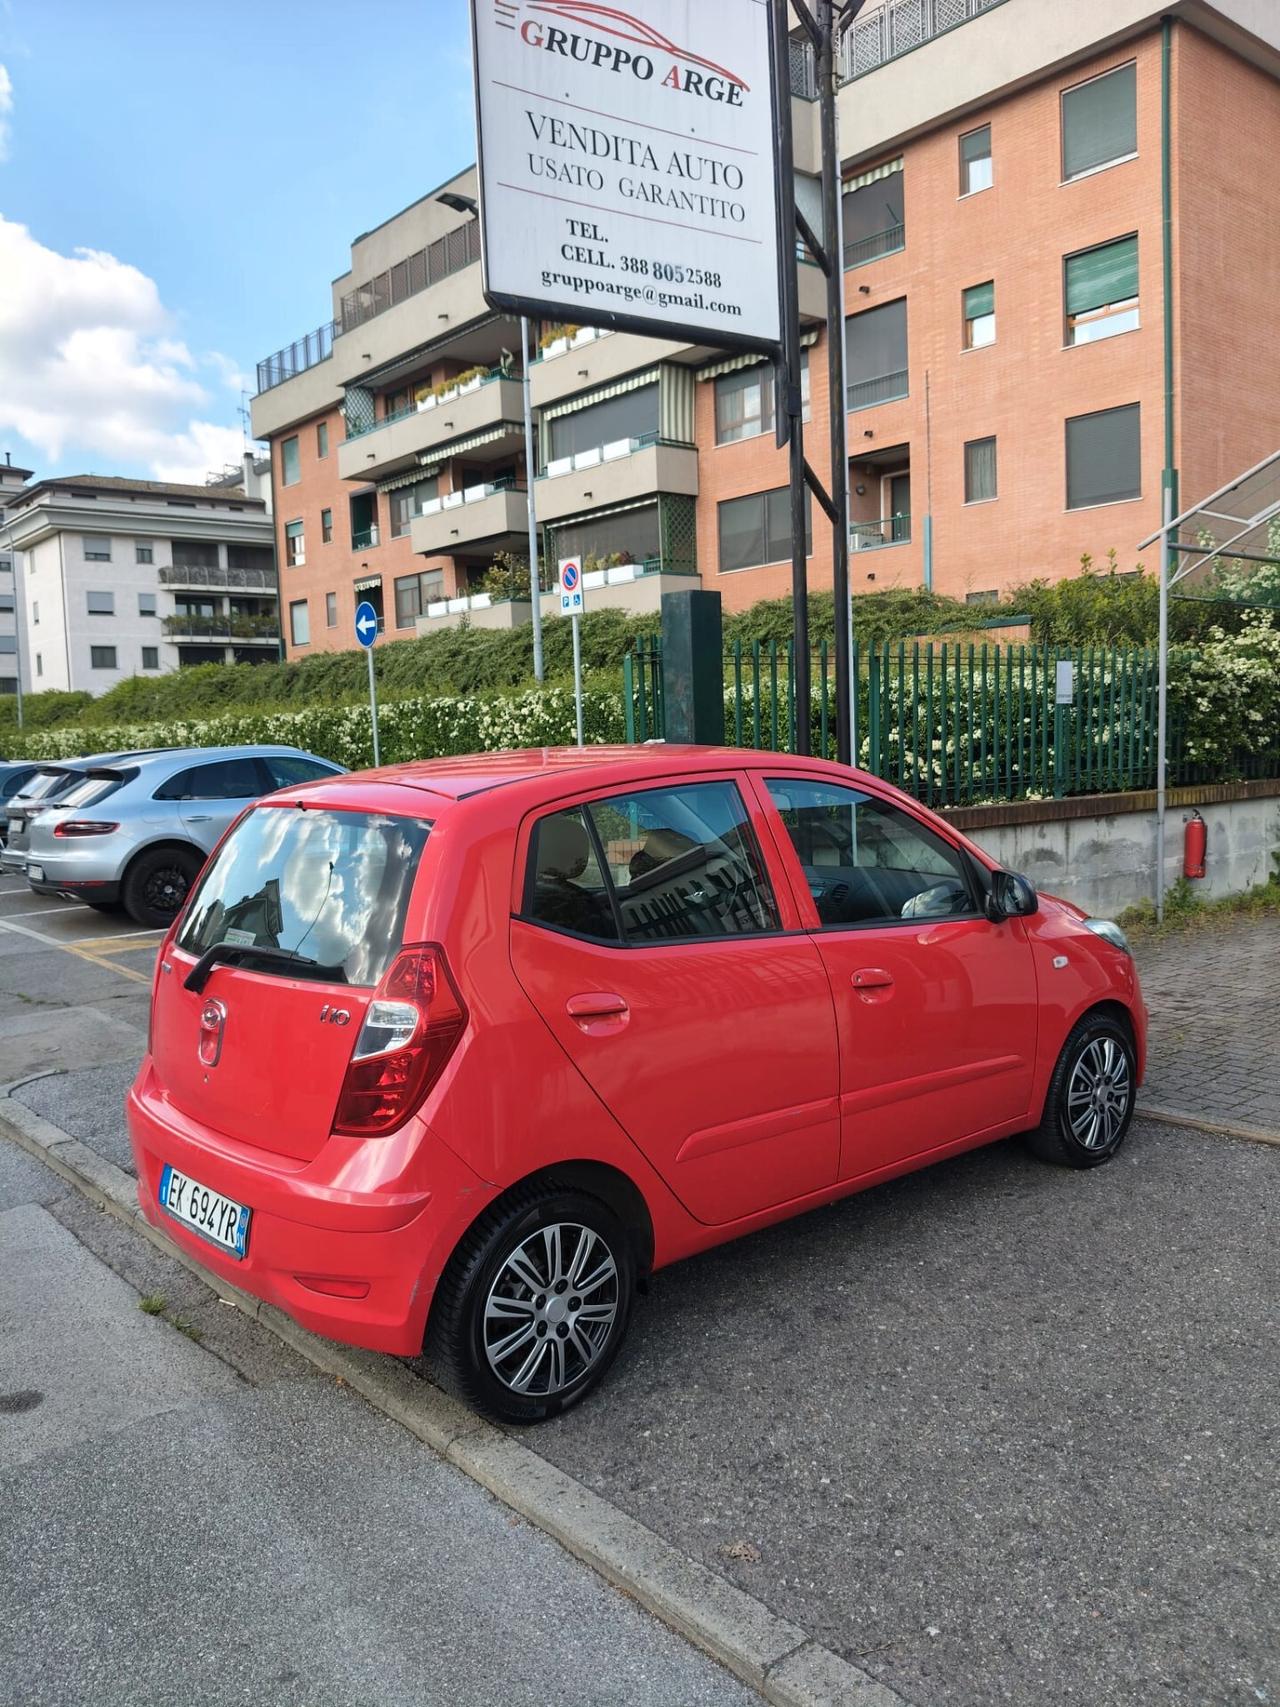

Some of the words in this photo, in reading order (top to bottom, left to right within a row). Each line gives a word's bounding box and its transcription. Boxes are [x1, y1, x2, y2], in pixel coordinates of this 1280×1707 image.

[520, 19, 654, 81] GRUPPO
[661, 64, 744, 107] ARGE
[524, 110, 658, 171] VENDITA
[666, 151, 743, 190] AUTO
[527, 153, 604, 191] USATO
[618, 177, 746, 223] GARANTITO
[566, 218, 609, 243] TEL.
[561, 244, 615, 270] CELL.
[620, 255, 649, 275] 388
[541, 270, 742, 316] gruppoarge@gmail.com
[168, 1173, 187, 1213] EK
